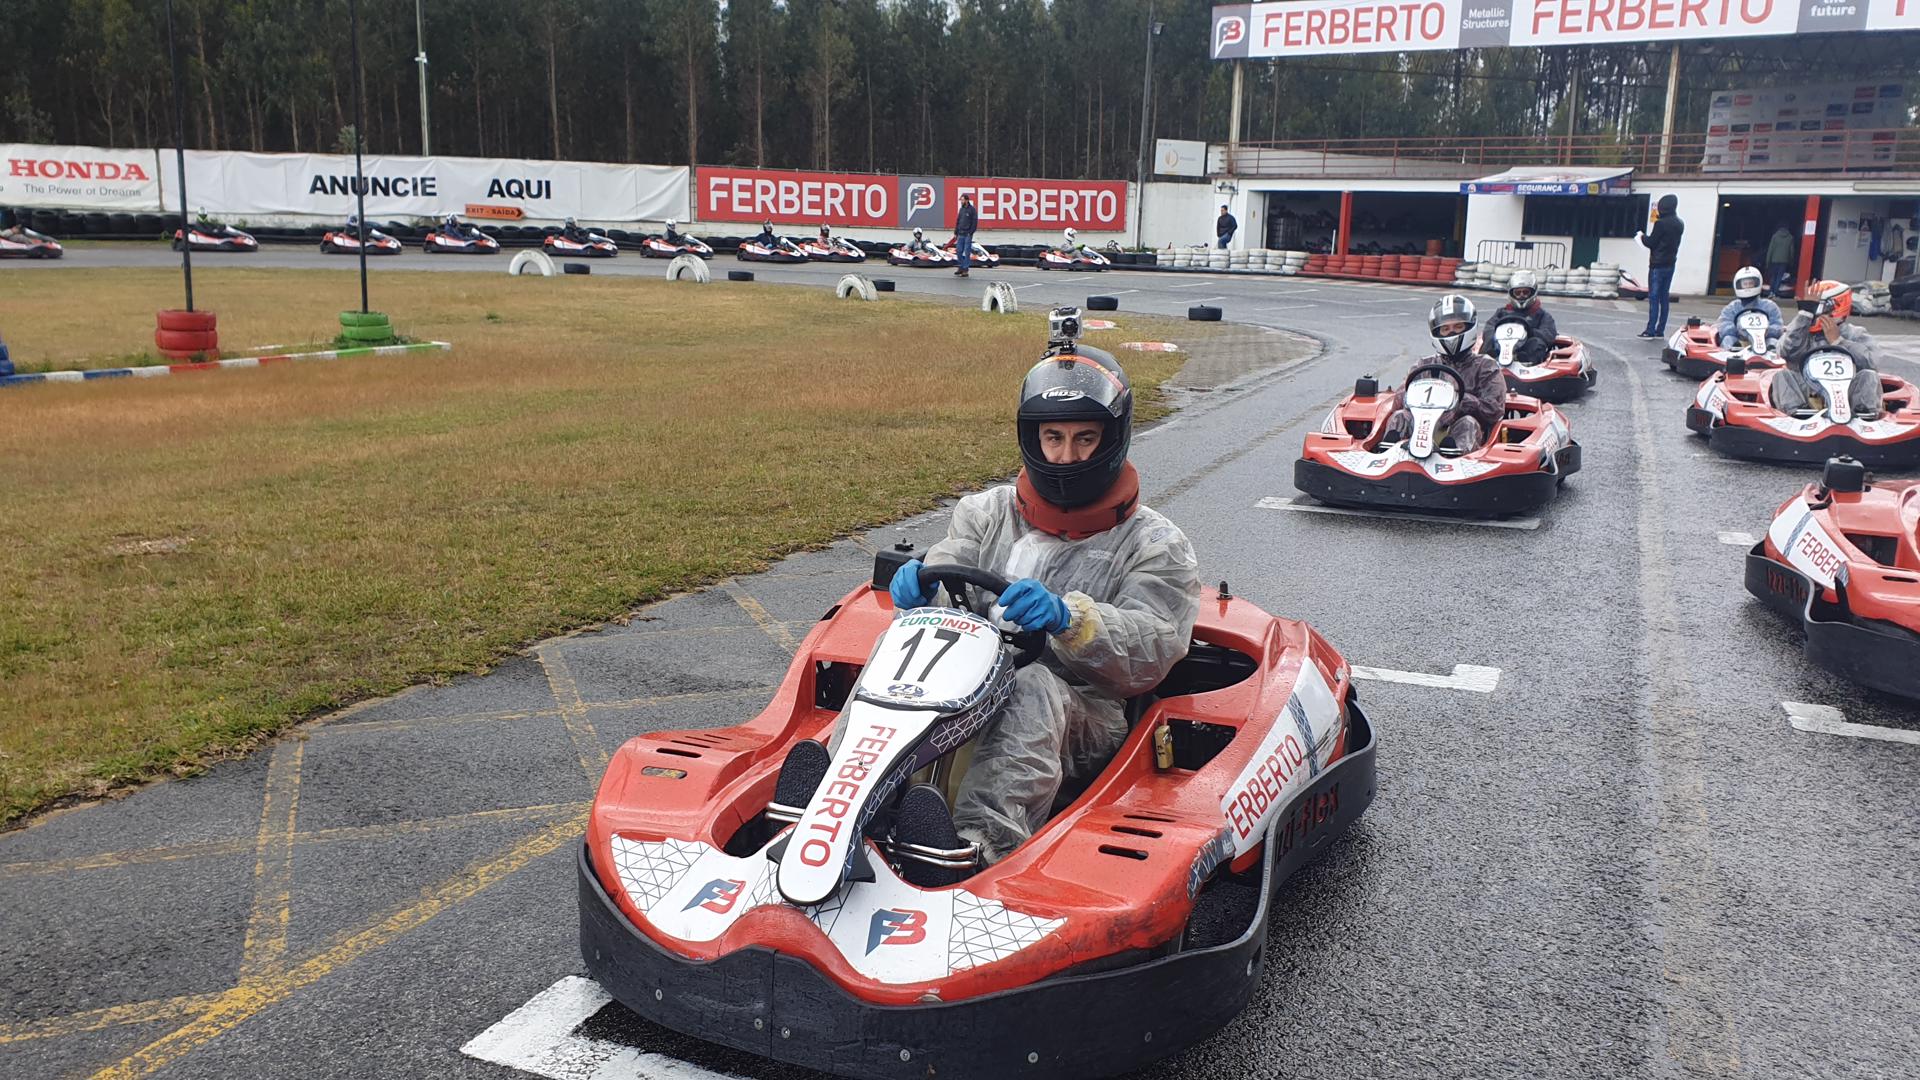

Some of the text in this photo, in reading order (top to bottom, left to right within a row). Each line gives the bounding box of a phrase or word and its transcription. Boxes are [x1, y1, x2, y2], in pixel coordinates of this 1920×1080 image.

[1469, 8, 1505, 18] Metallic
[1811, 5, 1856, 16] future
[1264, 2, 1445, 47] FERBERTO
[1462, 19, 1509, 29] Structures
[8, 158, 150, 181] HONDA
[24, 183, 141, 197] The Power of Dreams
[309, 174, 551, 200] ANUNCIE AQUI
[710, 177, 887, 218] FERBERTO
[1748, 316, 1761, 326] 23
[1507, 327, 1513, 337] 9
[1822, 360, 1845, 375] 25
[1424, 386, 1433, 403] 1
[899, 616, 982, 633] EUROINDY
[893, 628, 962, 682] 17
[800, 724, 897, 868] FERBERTO
